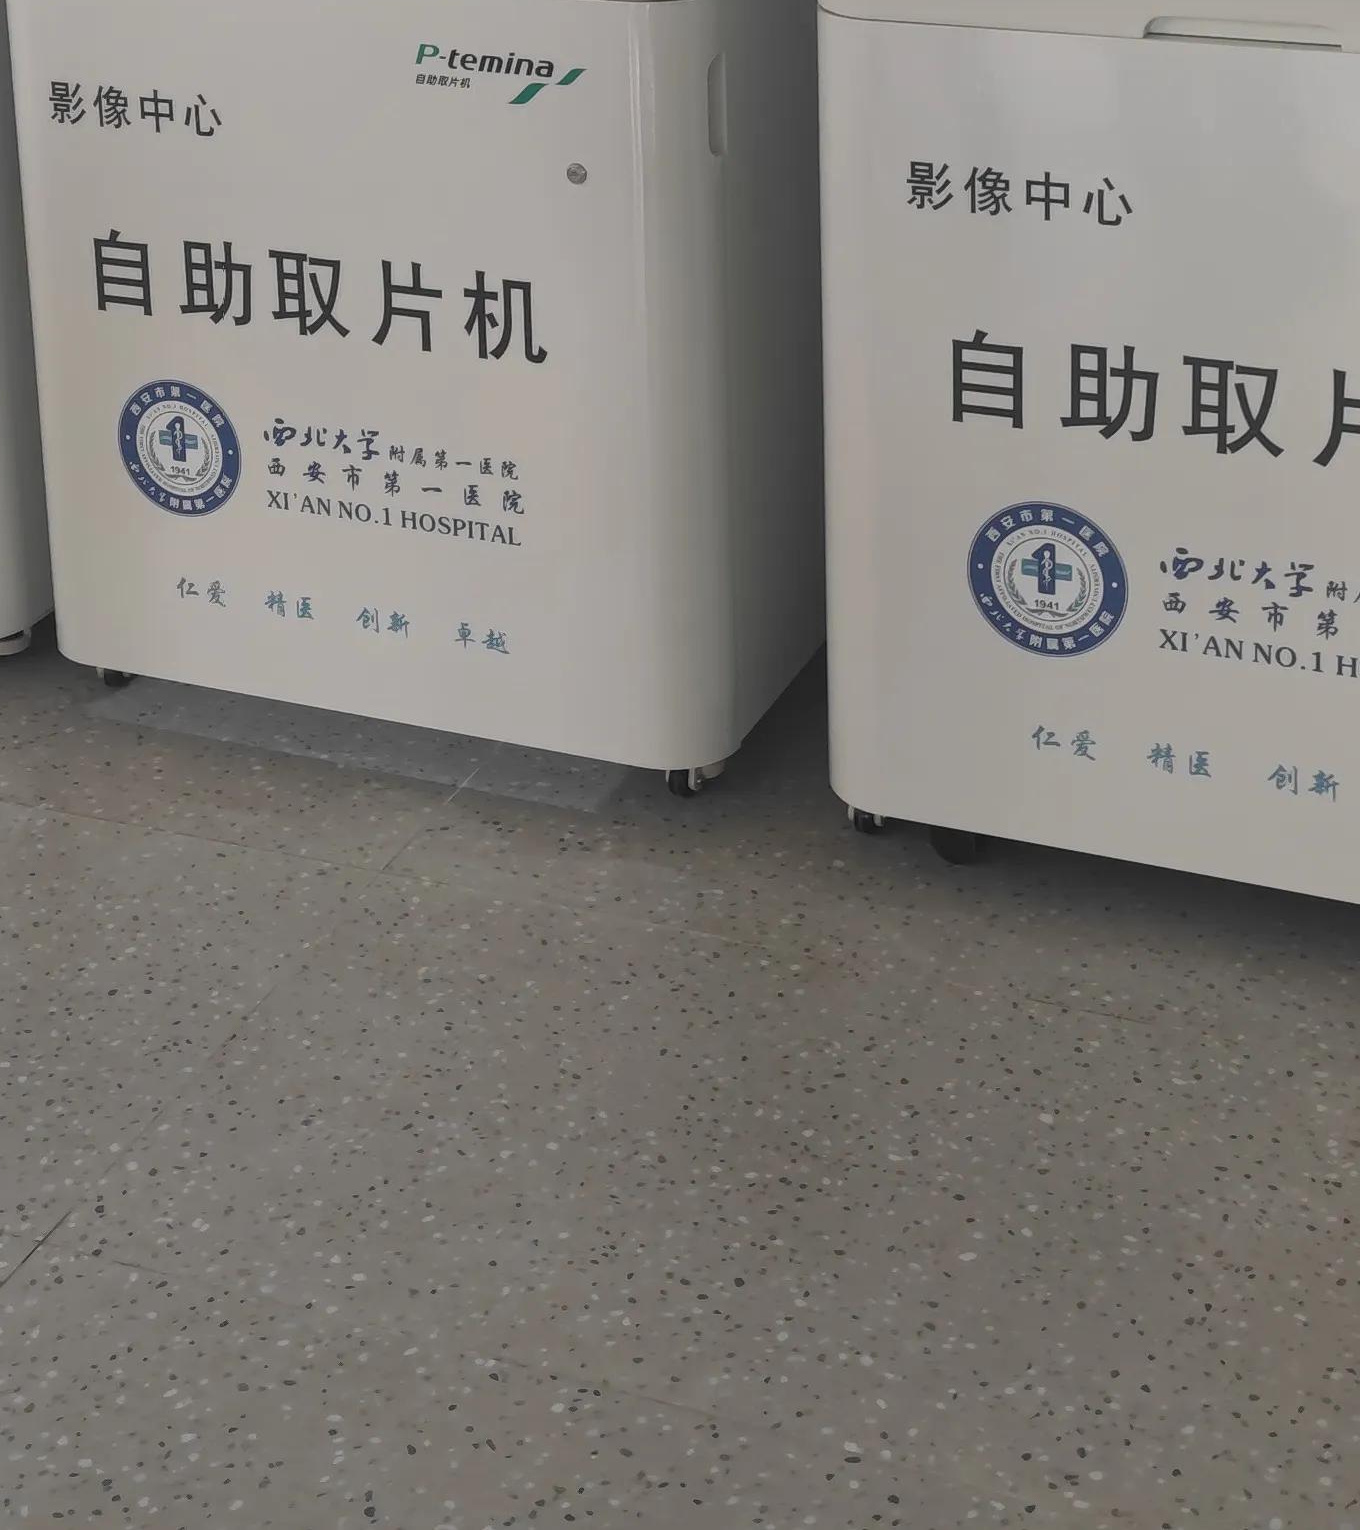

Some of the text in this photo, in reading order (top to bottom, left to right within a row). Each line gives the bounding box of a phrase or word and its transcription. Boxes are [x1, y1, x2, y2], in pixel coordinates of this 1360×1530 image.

[415, 43, 555, 78] P-temina
[415, 73, 472, 89] 自助取片机
[49, 81, 223, 137] 影像中心
[906, 161, 1134, 226] 影像中心
[93, 228, 548, 364] 自助取片机
[267, 457, 525, 515] 西安市第一医院
[338, 500, 392, 526] NO.1
[400, 510, 522, 546] HOSPITAL
[264, 590, 315, 620] 精医
[356, 607, 410, 638] 创新
[454, 622, 510, 655] 卓越
[1034, 599, 1059, 610] 1941
[1252, 642, 1325, 673] NO.1
[1146, 742, 1213, 778] 精医
[1267, 765, 1340, 803] 创新
